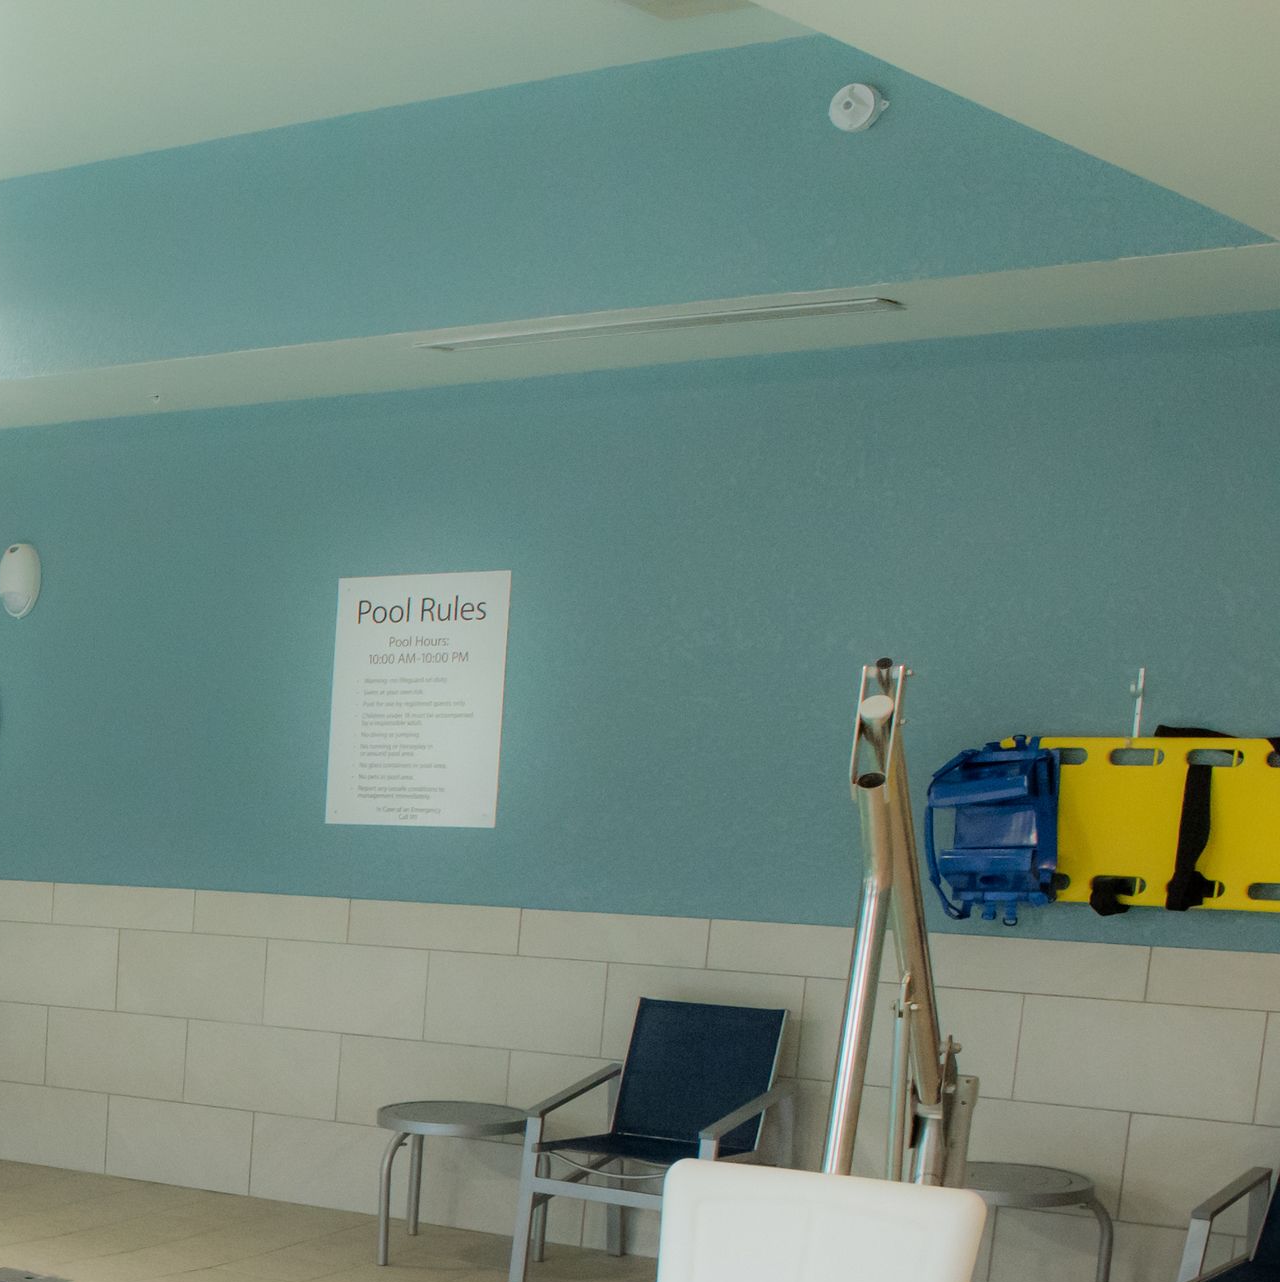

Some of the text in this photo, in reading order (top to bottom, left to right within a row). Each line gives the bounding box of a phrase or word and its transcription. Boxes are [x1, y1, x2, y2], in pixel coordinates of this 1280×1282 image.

[357, 595, 487, 625] Pool Rules
[389, 635, 450, 648] Pool Hours:
[369, 653, 395, 665] 10:00
[451, 651, 469, 663] PM
